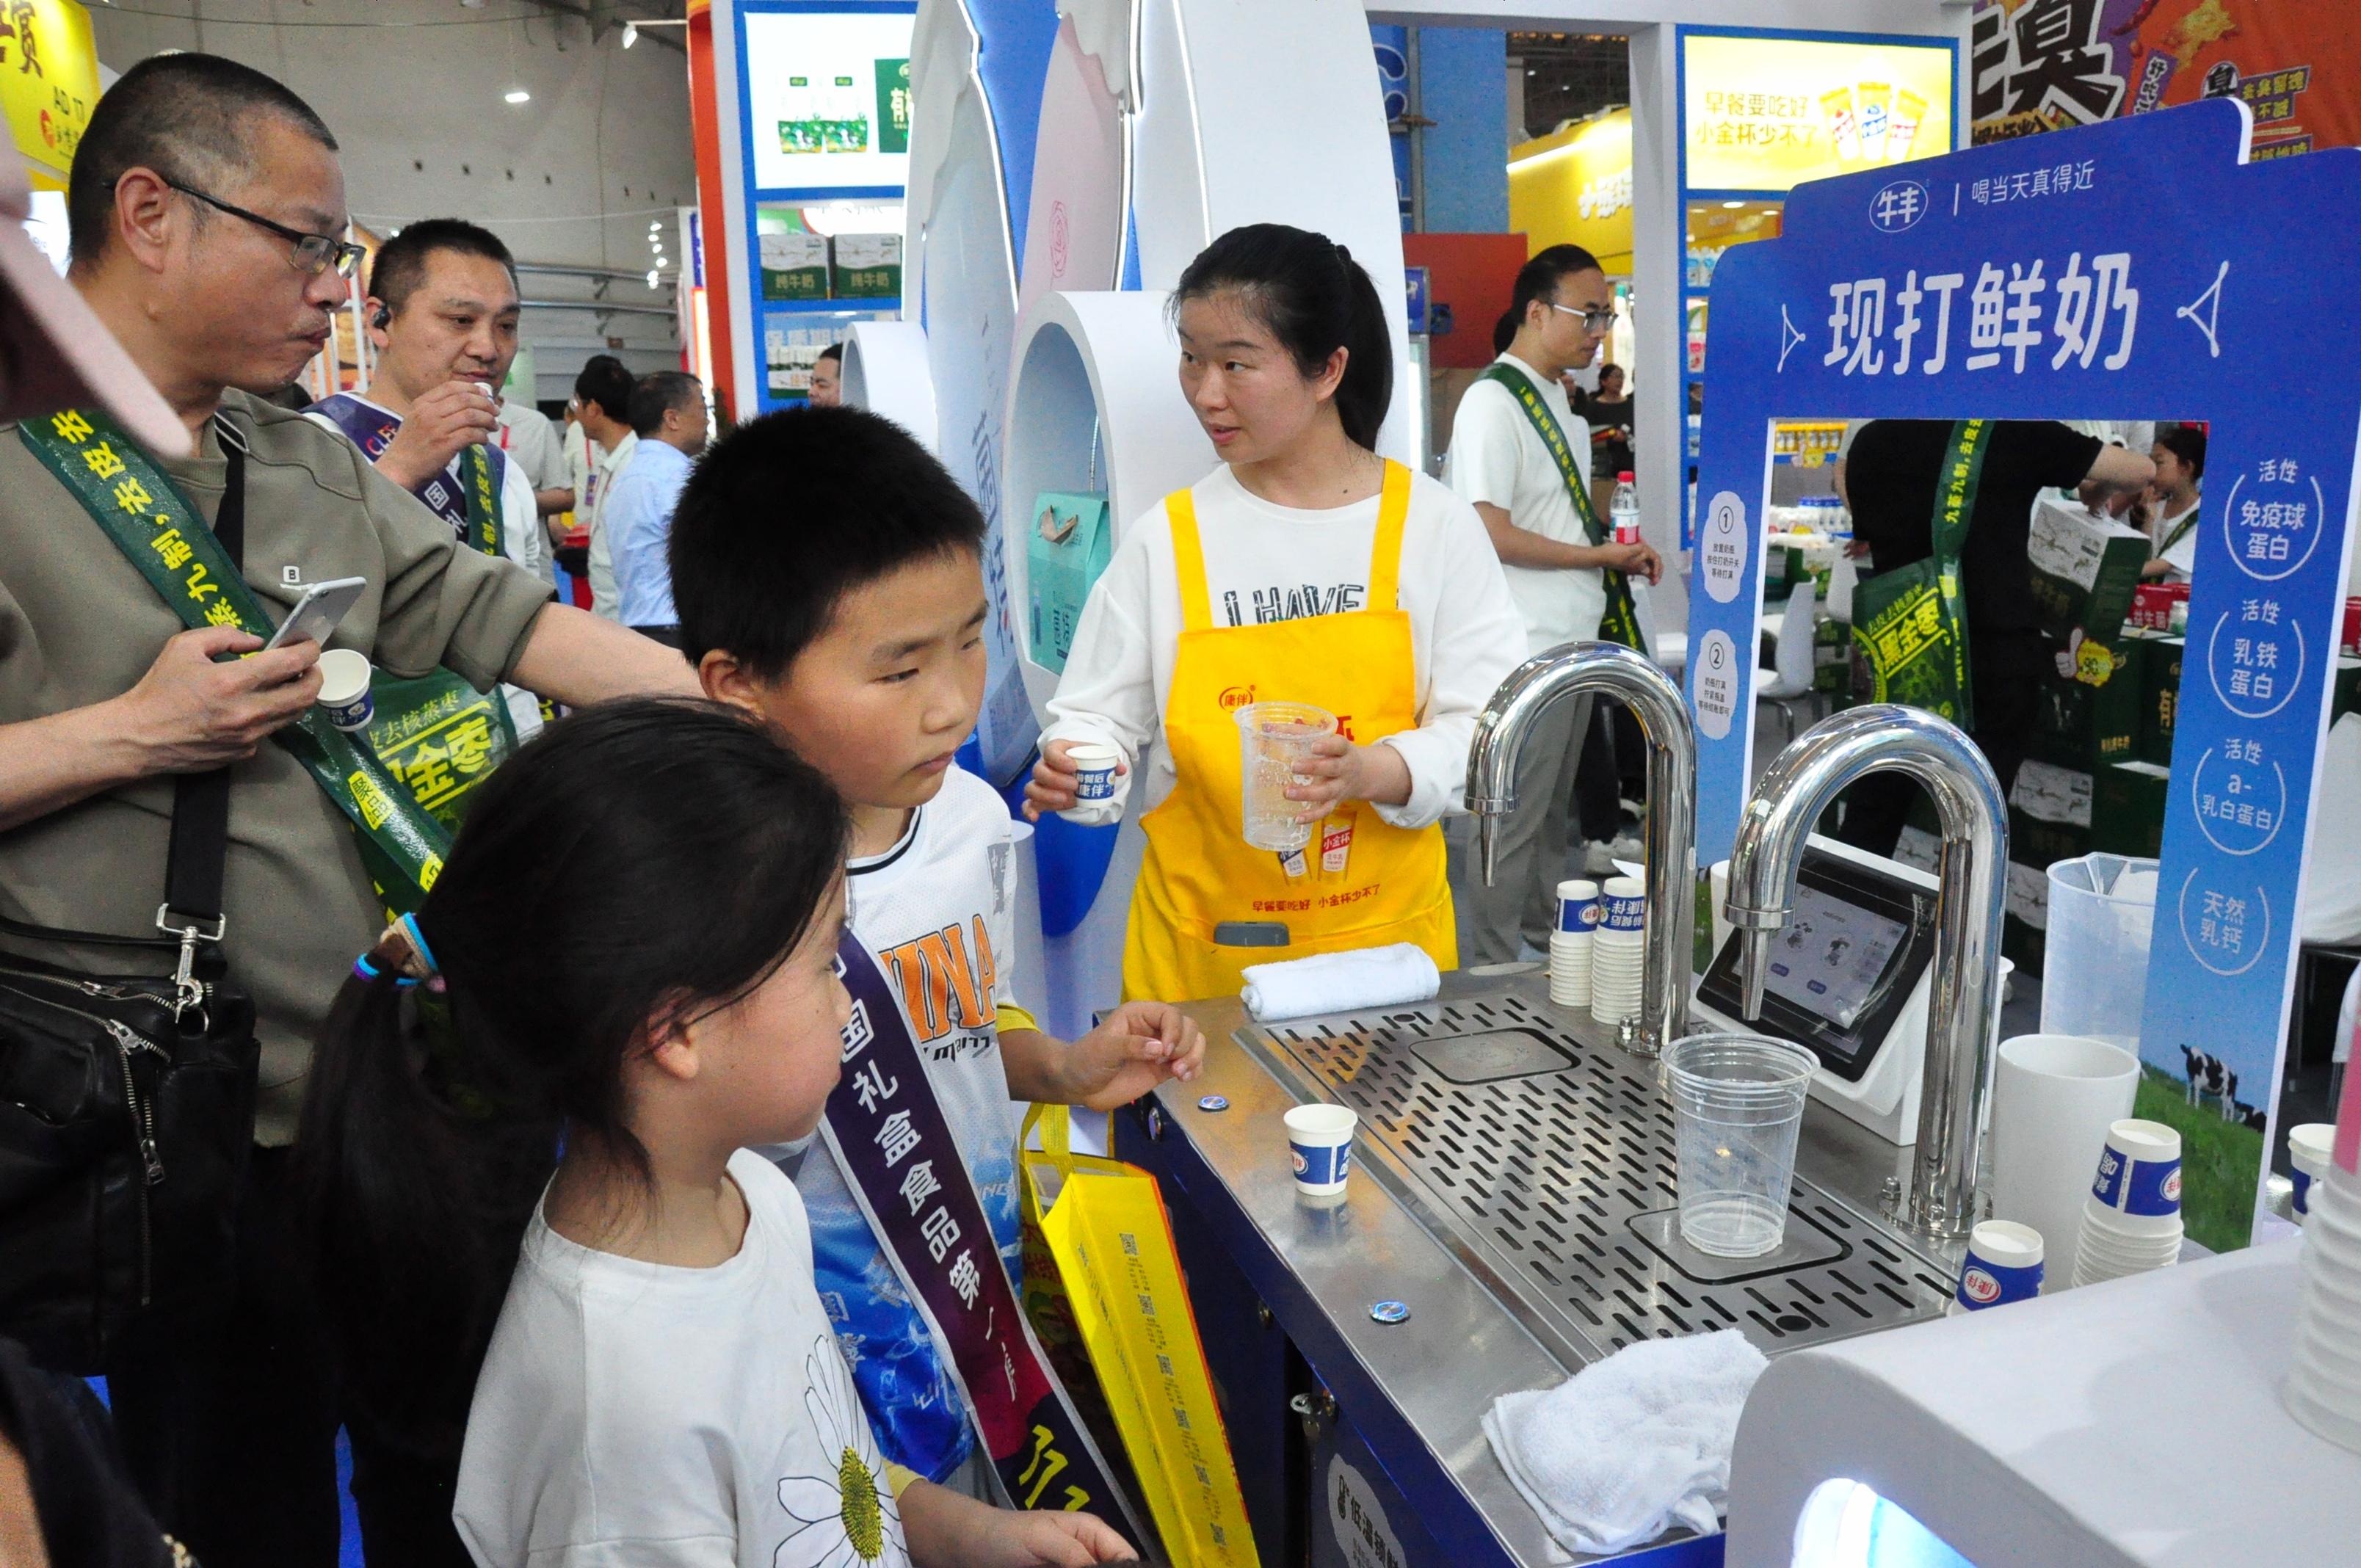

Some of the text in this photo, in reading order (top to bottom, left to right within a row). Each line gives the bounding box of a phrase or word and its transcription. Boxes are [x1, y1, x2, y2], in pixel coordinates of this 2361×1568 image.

[1705, 91, 1809, 117] 早餐要吃好
[1697, 120, 1818, 149] 小金杯少不了
[1972, 159, 2095, 206] 喝当天真得近
[1824, 252, 2139, 377] 现打鲜奶
[2258, 458, 2299, 484] 活性
[2241, 500, 2307, 531] 免疫球
[2246, 533, 2290, 561] 蛋白
[2241, 599, 2281, 625] 活性
[2233, 638, 2278, 669] 乳铁
[2230, 669, 2274, 700] 蛋白
[1224, 694, 1248, 707] 康伴
[2159, 689, 2179, 728] 有
[385, 715, 492, 804] 金枣
[2225, 738, 2263, 765] 活性
[2202, 795, 2271, 830] 乳白蛋白
[1323, 832, 1351, 851] 小金杯
[1252, 883, 1381, 912] 早餐要吃好 小金杯少不了
[2204, 890, 2246, 925] 天然
[2201, 918, 2243, 954] 乳钙
